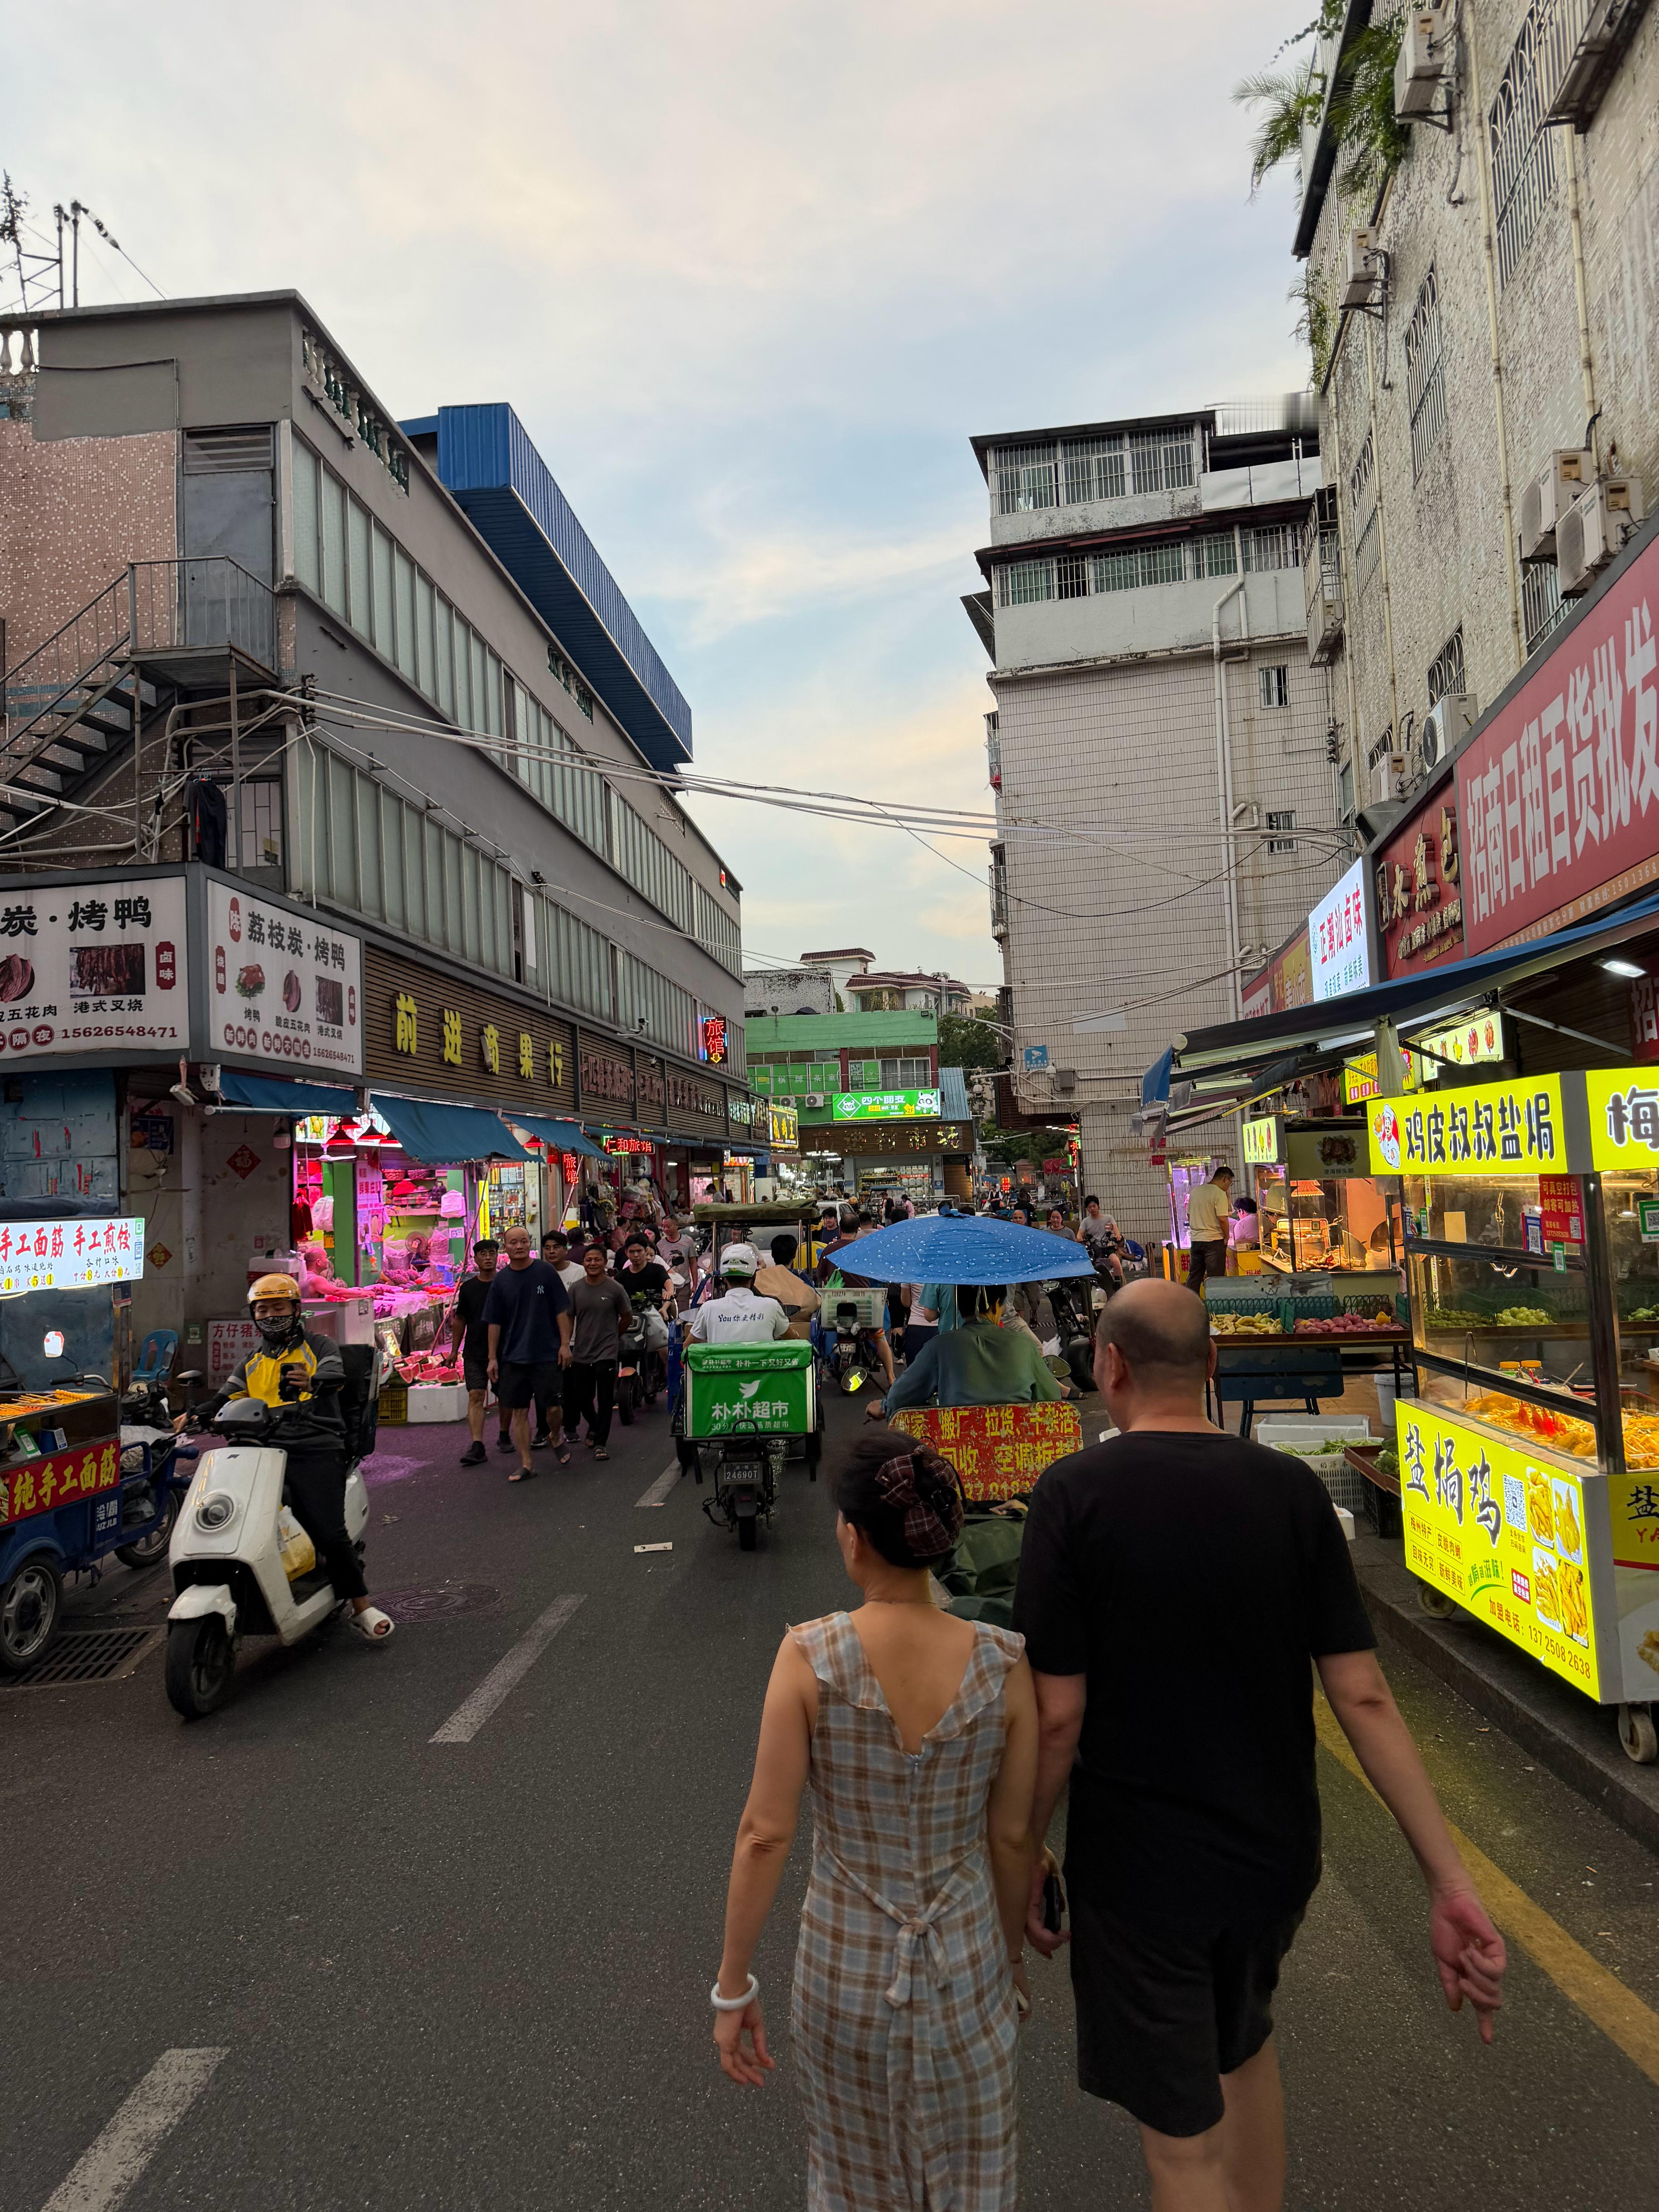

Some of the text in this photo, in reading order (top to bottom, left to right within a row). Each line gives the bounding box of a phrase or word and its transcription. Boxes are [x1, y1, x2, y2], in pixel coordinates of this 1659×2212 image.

[1467, 598, 1659, 926] 招商日租百货批发
[0, 896, 151, 937] 炭·烤鸭
[1320, 883, 1362, 965] 正潮汕卤味
[247, 911, 345, 971] 荔枝炭·烤鸭
[159, 951, 174, 981] 卤味
[74, 999, 143, 1014] 港式叉烧
[244, 1007, 261, 1023] 烤鸭
[1632, 977, 1659, 1044] 招
[62, 1026, 178, 1039] 15626548471
[275, 1015, 310, 1034] 脆皮五花肉
[317, 1025, 343, 1040] 港式叉烧
[706, 1018, 725, 1054] 旅馆
[313, 1047, 355, 1064] 15626548471
[862, 1095, 905, 1105] 四个朋友
[1405, 1091, 1554, 1164] 鸡皮叔叔盐焗
[606, 1138, 652, 1153] 仁和旅馆
[565, 1154, 577, 1183] 旅馆
[1542, 1181, 1578, 1195] 可真空打包
[0, 1222, 131, 1262] 手工面筋 手工煎饺
[718, 1314, 731, 1322] You
[736, 1358, 799, 1367] 朴朴一下又好又省
[711, 1400, 789, 1420] 朴朴超市
[711, 1421, 789, 1431] 30分快送品质超市
[941, 1410, 969, 1440] 搬厂
[14, 1443, 117, 1515] 纯手工面筋
[1404, 1420, 1503, 1548] 盐焗鸡
[1410, 1515, 1432, 1540] 梅州特产
[1412, 1544, 1434, 1571] 回味无穷
[1437, 1532, 1461, 1560] 皮脆肉嫩
[1439, 1561, 1463, 1591] 新鲜美味
[1528, 1625, 1542, 1646] 137
[1545, 1635, 1566, 1663] 2508
[1568, 1650, 1591, 1680] 2638
